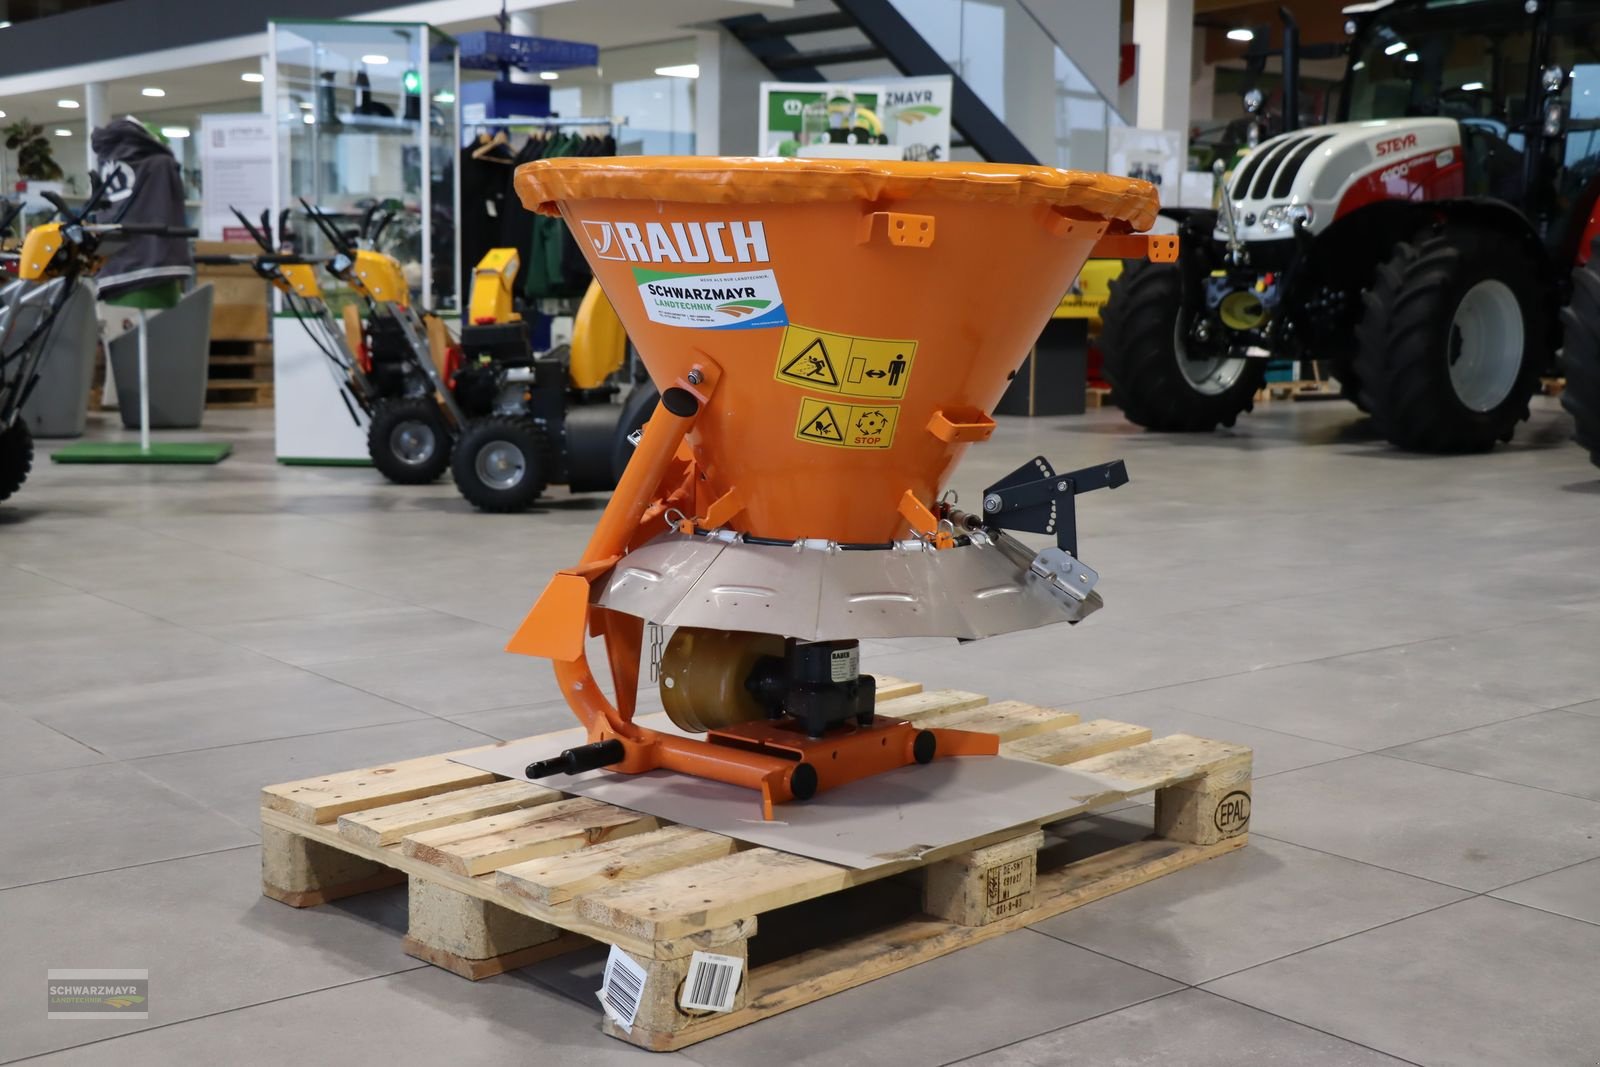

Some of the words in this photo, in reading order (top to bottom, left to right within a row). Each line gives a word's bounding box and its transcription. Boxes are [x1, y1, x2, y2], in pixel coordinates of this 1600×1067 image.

[1376, 133, 1416, 157] STEYR
[614, 221, 770, 263] RAUCH
[648, 284, 757, 300] SCHWARZMAYR
[654, 299, 714, 311] LANDTECHNIK
[1220, 799, 1247, 826] EPAL
